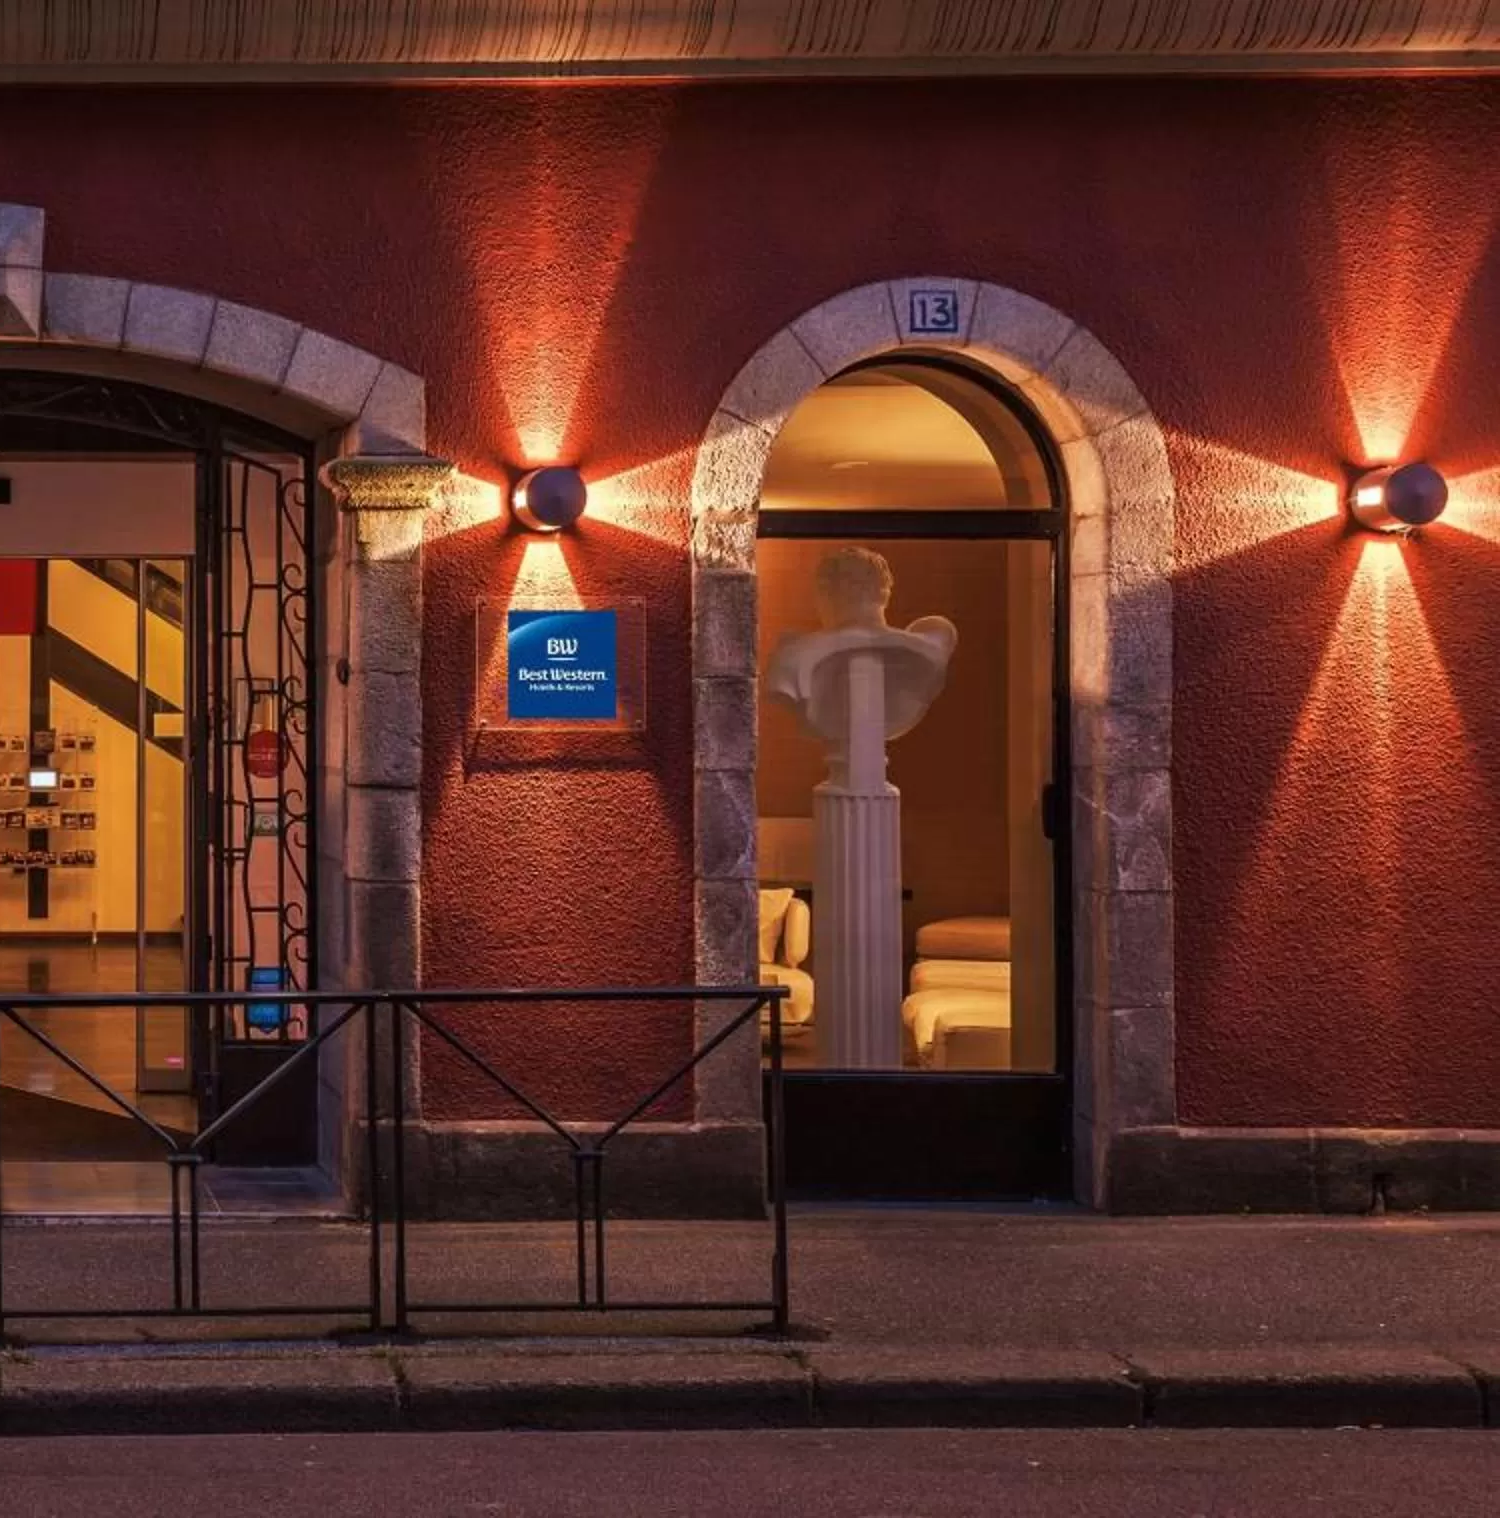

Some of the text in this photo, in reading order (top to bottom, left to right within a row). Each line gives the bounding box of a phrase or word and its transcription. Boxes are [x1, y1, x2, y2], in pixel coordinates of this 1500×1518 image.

[917, 297, 951, 327] 13
[547, 638, 578, 655] BW
[519, 668, 548, 681] Best
